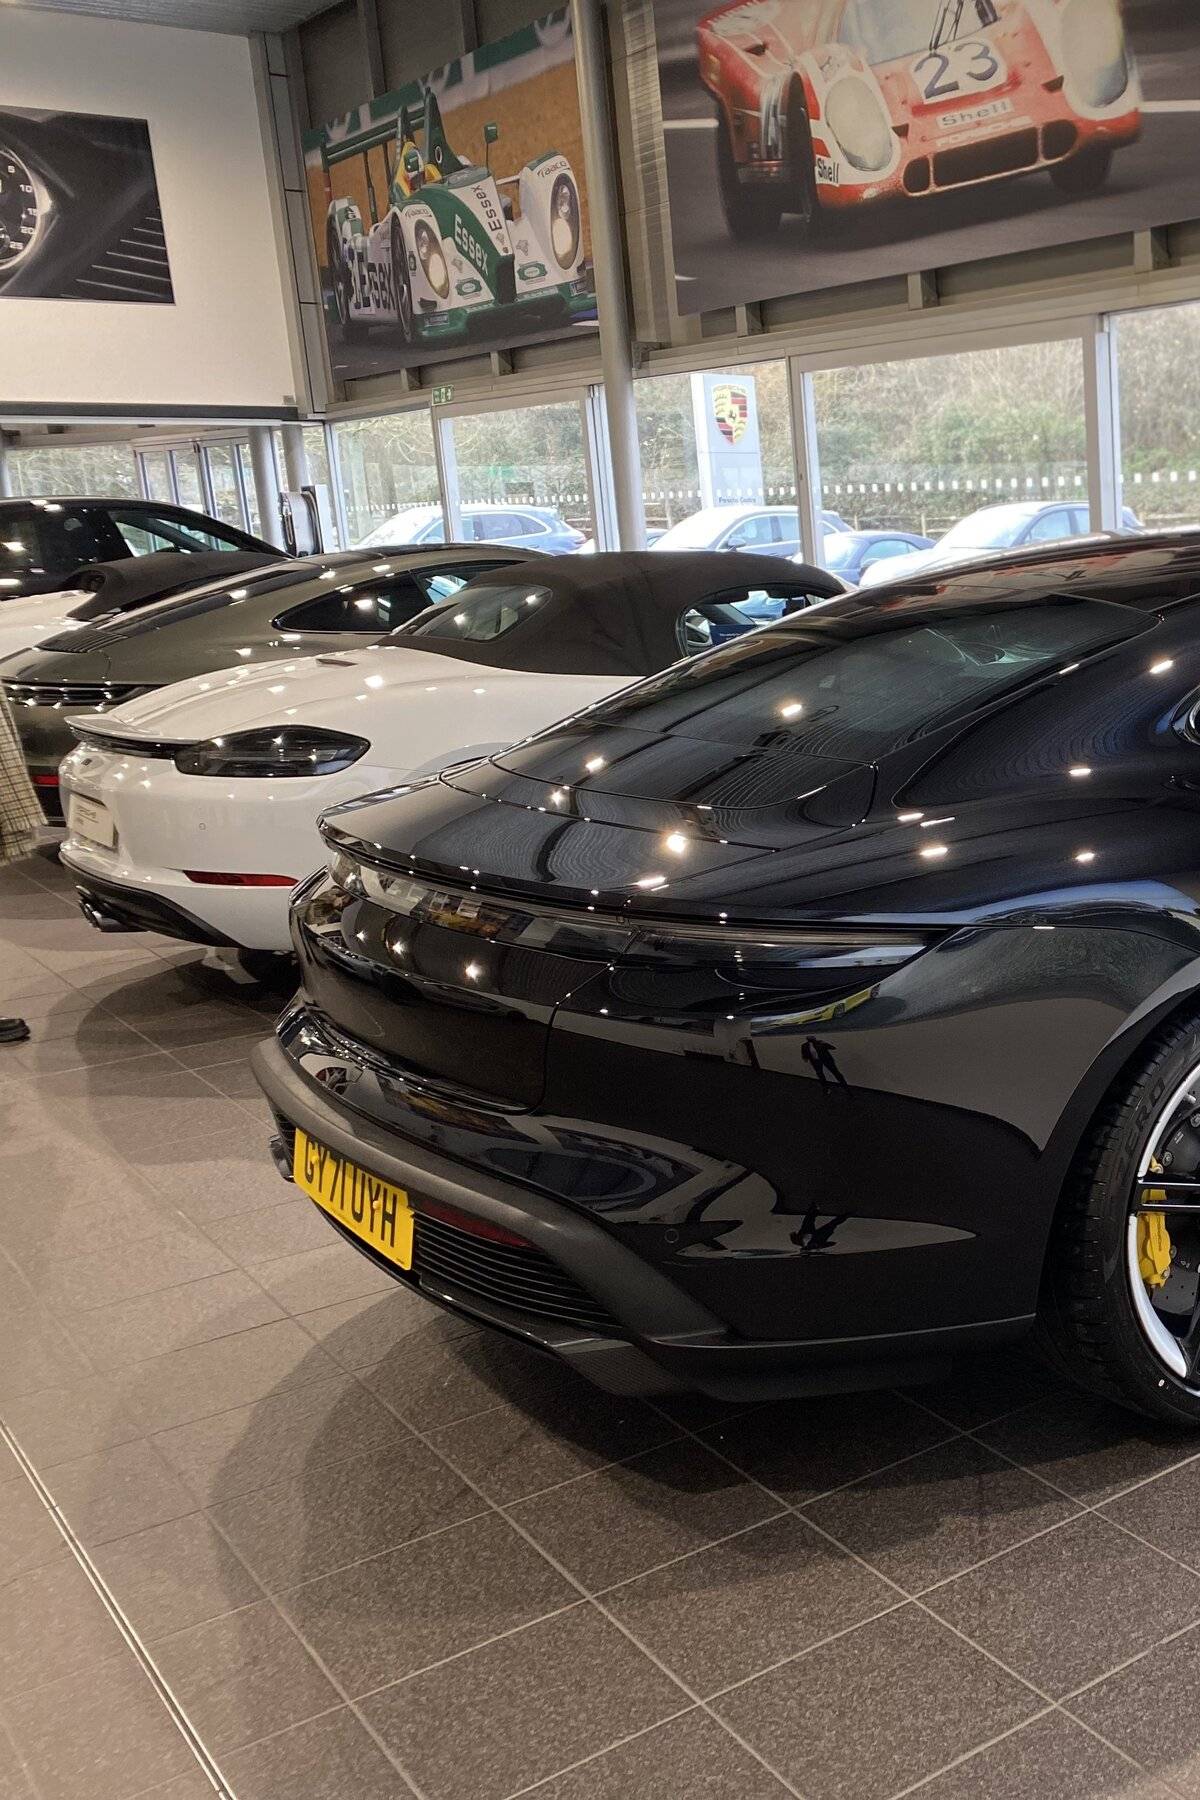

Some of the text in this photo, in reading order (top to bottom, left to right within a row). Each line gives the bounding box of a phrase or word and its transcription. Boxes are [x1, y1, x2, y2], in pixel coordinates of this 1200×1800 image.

[914, 41, 999, 100] 23
[941, 100, 1008, 126] Shell
[20, 184, 33, 194] 10
[816, 156, 840, 185] Shell
[471, 184, 504, 232] Essex
[454, 212, 489, 275] Essex
[304, 1136, 398, 1249] GY71 UYH
